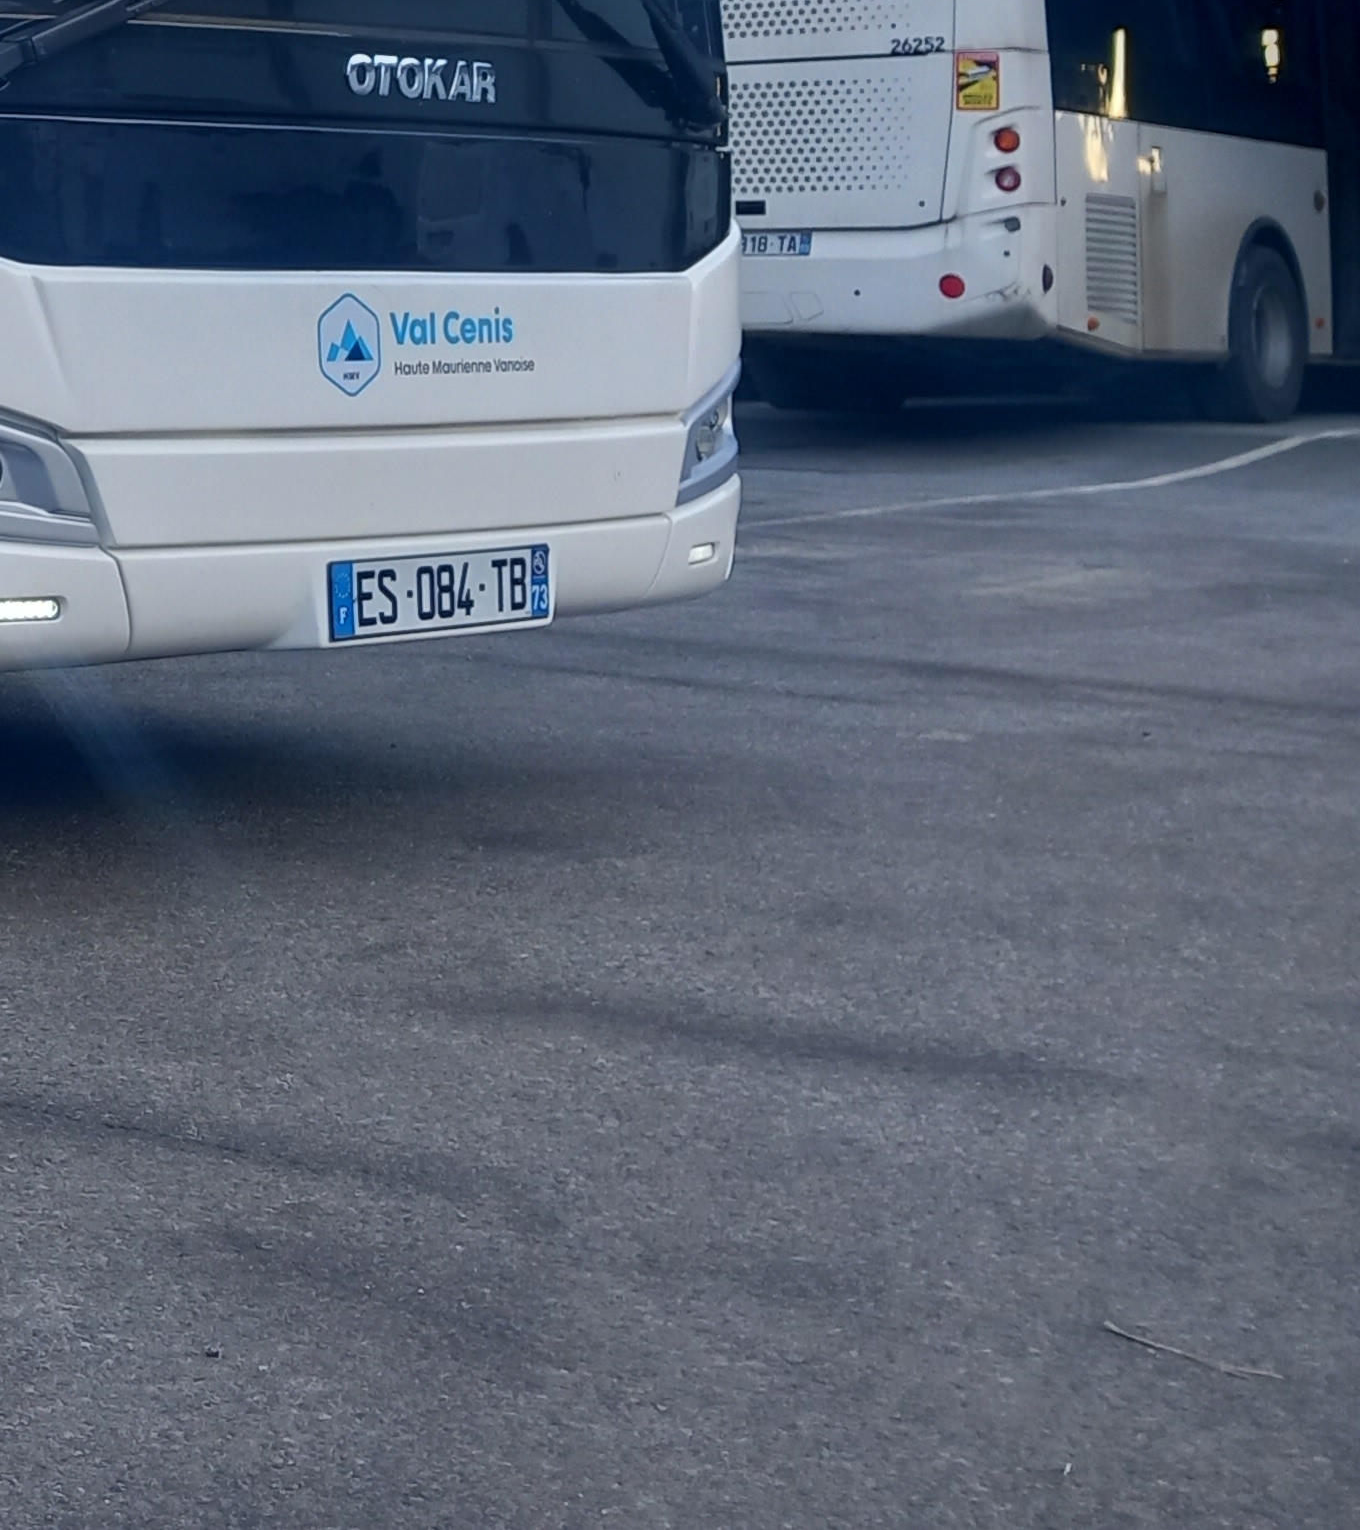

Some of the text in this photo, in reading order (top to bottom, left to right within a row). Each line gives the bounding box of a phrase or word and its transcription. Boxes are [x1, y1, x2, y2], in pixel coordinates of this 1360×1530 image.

[890, 36, 945, 55] 26252
[346, 53, 497, 103] OTOKAR
[390, 306, 514, 346] Val Cenis
[394, 356, 535, 376] Haute Maurienne Vanoise
[339, 607, 348, 625] F
[531, 585, 548, 611] 73
